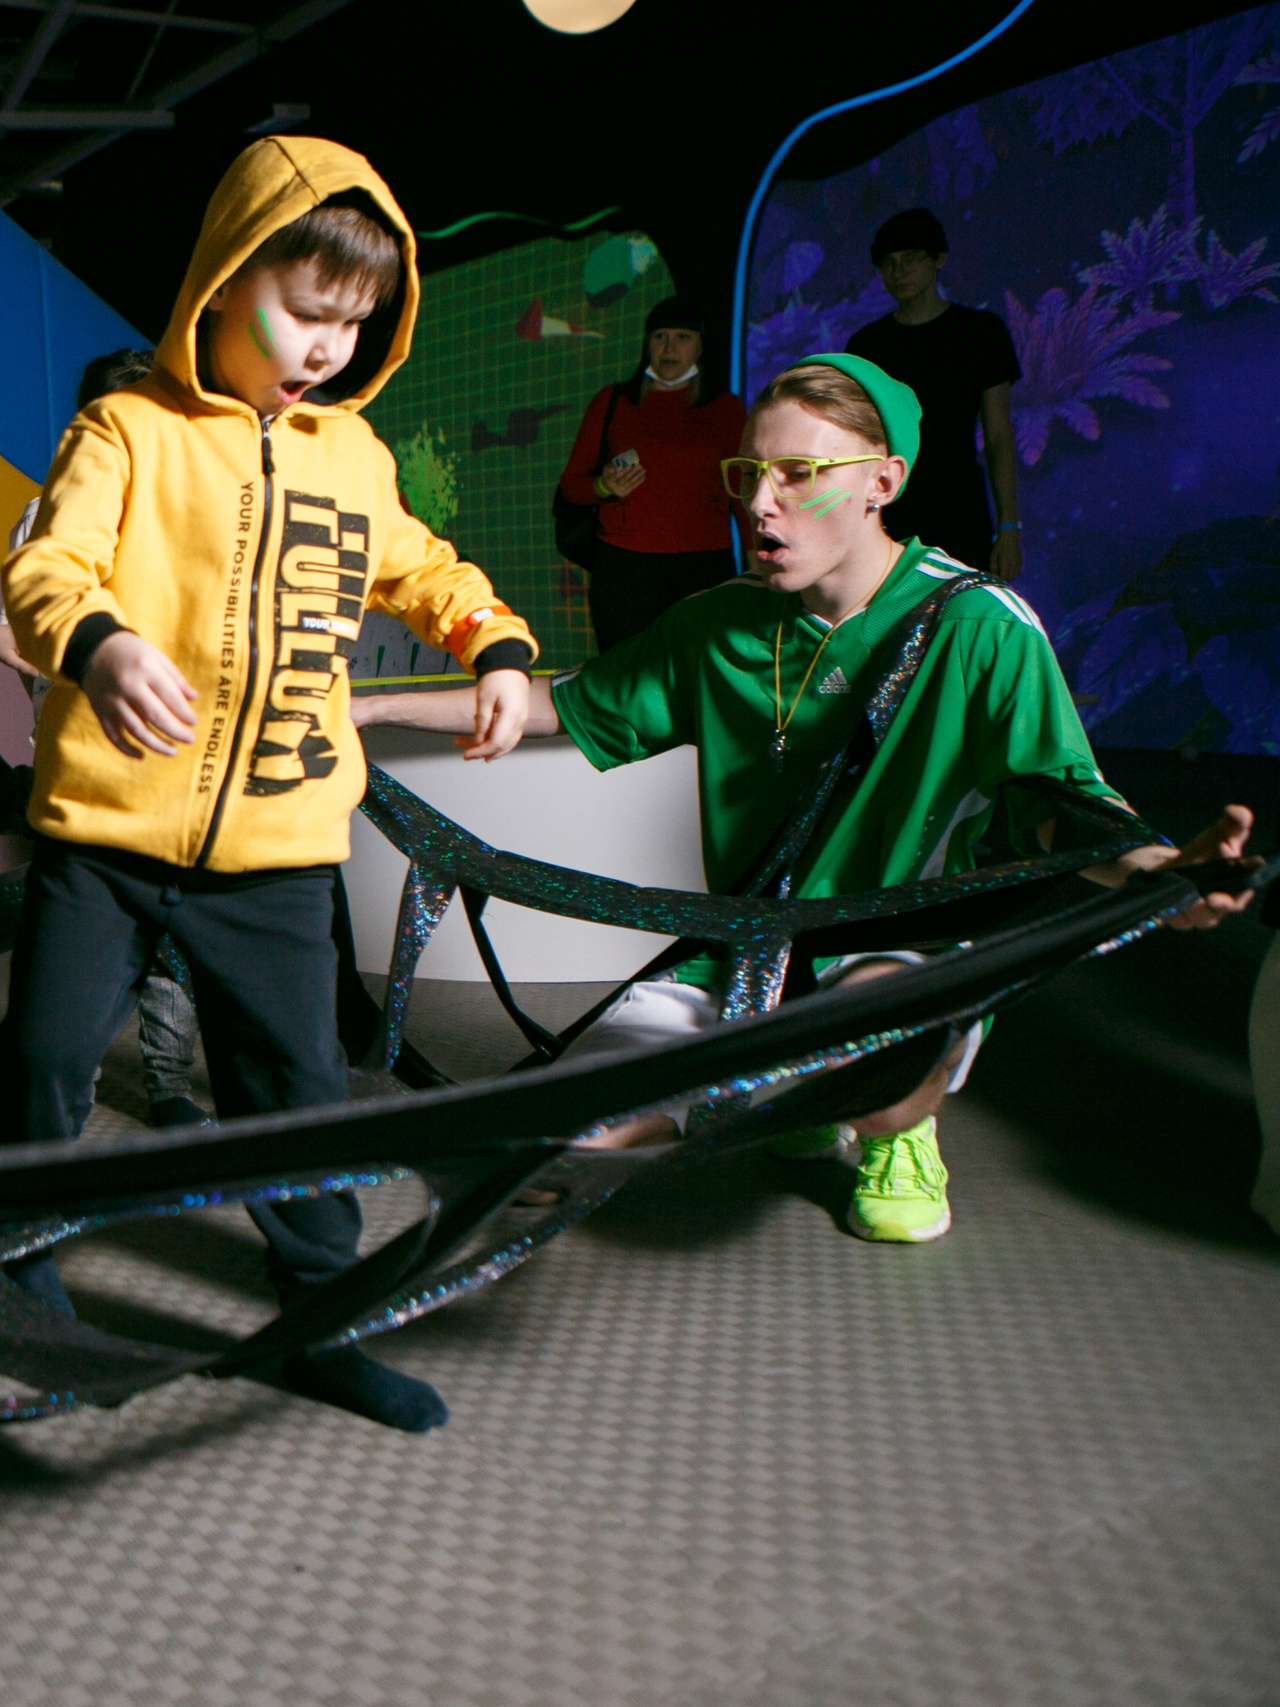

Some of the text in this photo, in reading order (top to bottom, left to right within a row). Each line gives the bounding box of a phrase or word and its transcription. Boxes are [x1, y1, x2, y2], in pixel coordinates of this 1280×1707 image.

[198, 482, 254, 794] YOUR POSSIBILITIES ARE ENDLESS
